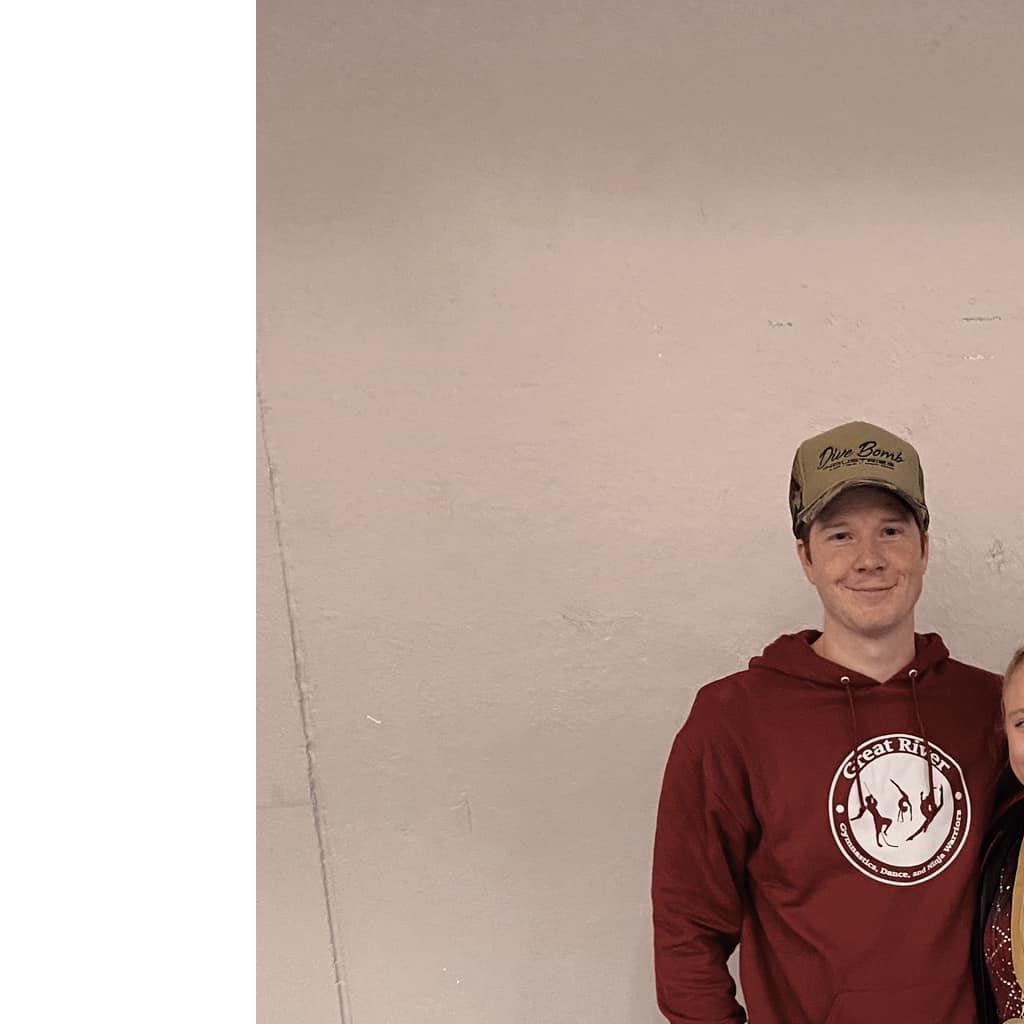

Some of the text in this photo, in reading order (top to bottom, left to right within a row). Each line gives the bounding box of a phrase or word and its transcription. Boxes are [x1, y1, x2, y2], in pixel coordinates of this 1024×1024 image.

[817, 440, 904, 470] Dive Bomb
[912, 867, 927, 878] and
[927, 853, 946, 871] Ninja
[944, 809, 962, 853] Warriors
